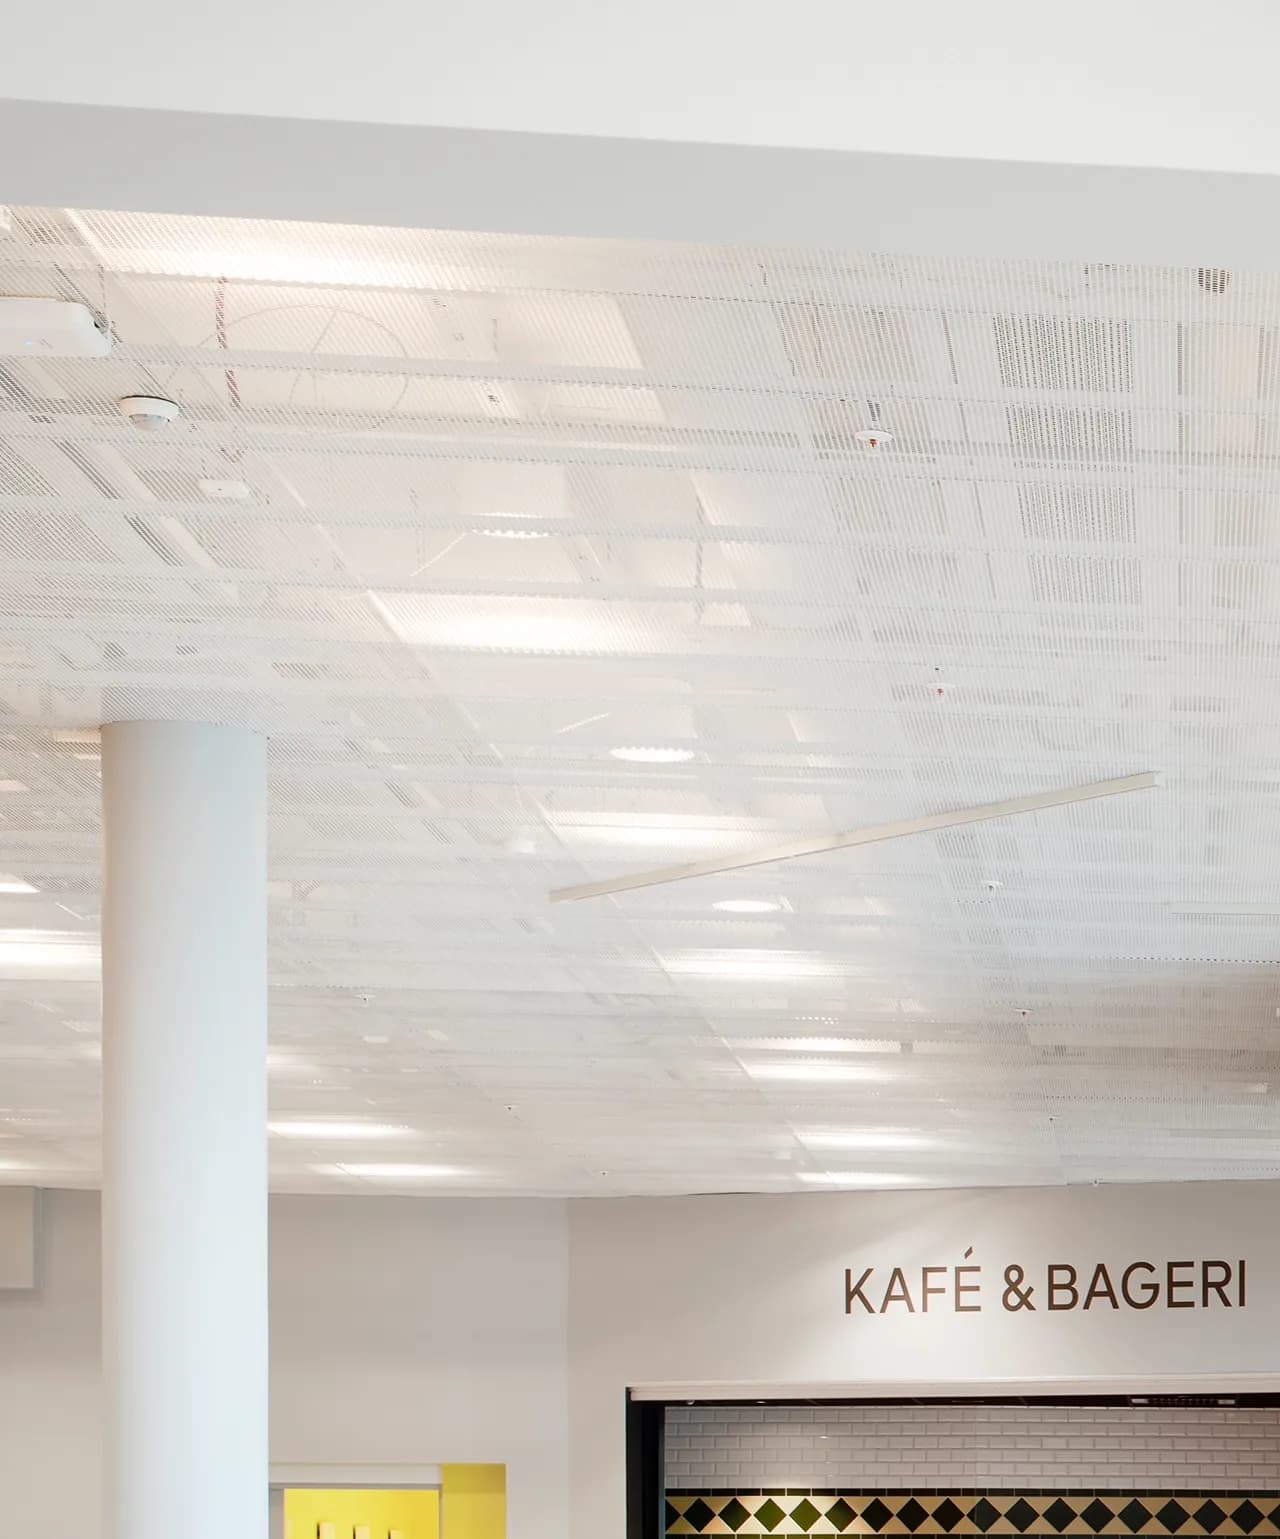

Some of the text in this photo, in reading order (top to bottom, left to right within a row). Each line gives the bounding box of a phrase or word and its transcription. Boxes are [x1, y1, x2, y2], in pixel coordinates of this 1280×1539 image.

[845, 1247, 1247, 1315] KAFÉ & BAGERI
